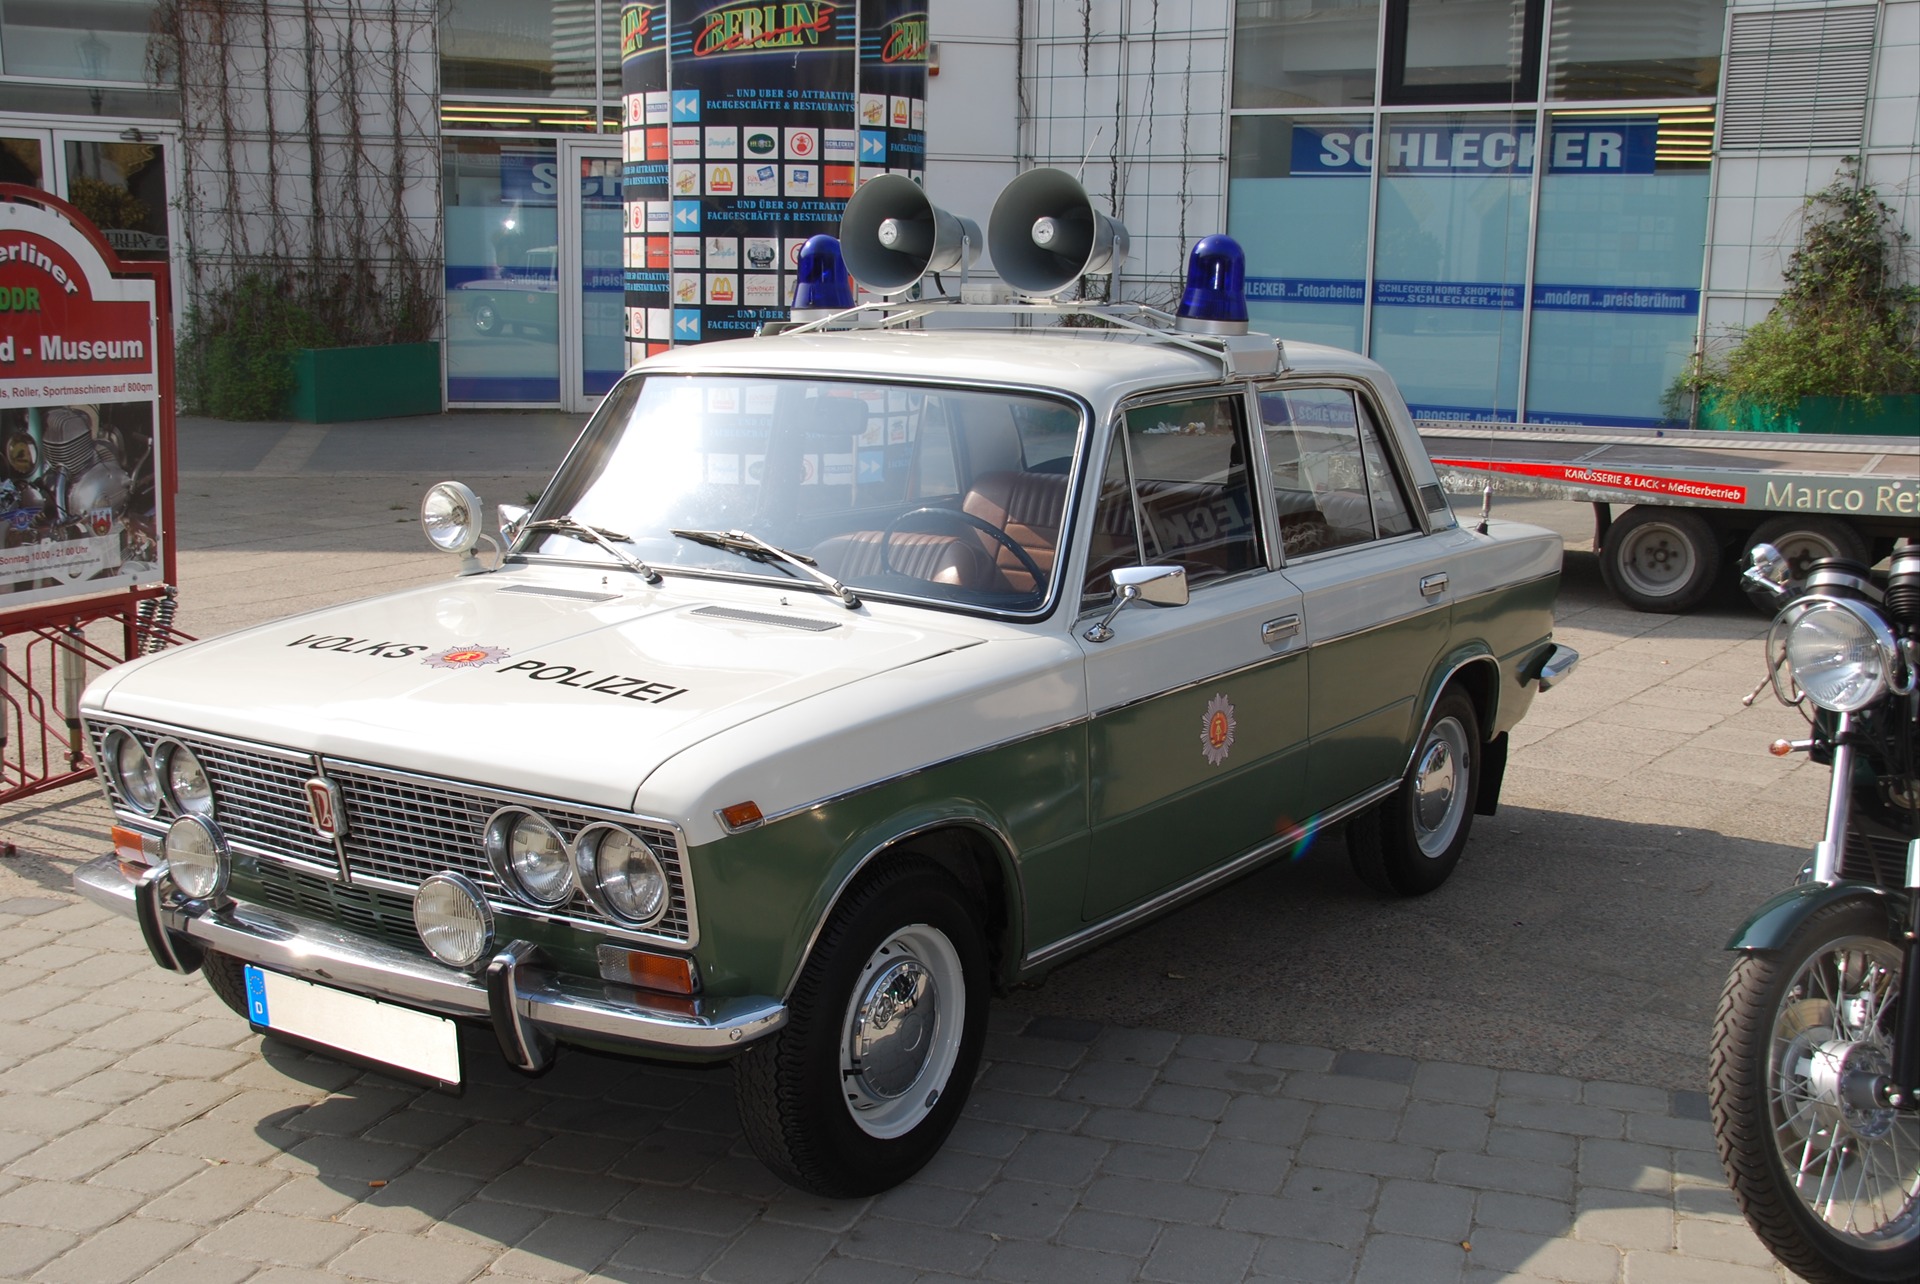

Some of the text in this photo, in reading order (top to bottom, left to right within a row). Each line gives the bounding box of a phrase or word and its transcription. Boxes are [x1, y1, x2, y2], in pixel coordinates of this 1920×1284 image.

[704, 2, 820, 51] BERLIN
[737, 89, 756, 98] UND
[786, 90, 799, 98] 50
[801, 90, 855, 101] ATTRAKTIVE
[707, 99, 781, 110] FACHGESCHÄFTE
[784, 101, 791, 110] &
[793, 101, 855, 112] RESTAURANTS
[737, 201, 756, 209] UND
[759, 199, 784, 209] ÜBER
[786, 201, 798, 209] 50
[707, 210, 781, 221] FACHGESCHÄFTE
[784, 213, 790, 221] &
[1378, 284, 1515, 297] SCHLECKER HOME SHOPPING
[0, 286, 40, 311] DDR
[1378, 294, 1514, 307] www.SCHLECKER.com
[737, 310, 757, 319] UND
[760, 308, 784, 319] ÜBER
[40, 335, 144, 361] Museum
[12, 387, 41, 398] Roller,
[43, 384, 111, 398] Sportmaschinen
[113, 383, 126, 393] auf
[127, 382, 154, 394] 800qm
[1565, 469, 1741, 500] KAROSSERIE & LACK Meisterbetrieb
[1765, 481, 1863, 511] Marco
[286, 634, 428, 659] VOLKS
[495, 660, 689, 704] POLIZEI
[254, 1000, 263, 1014] D
